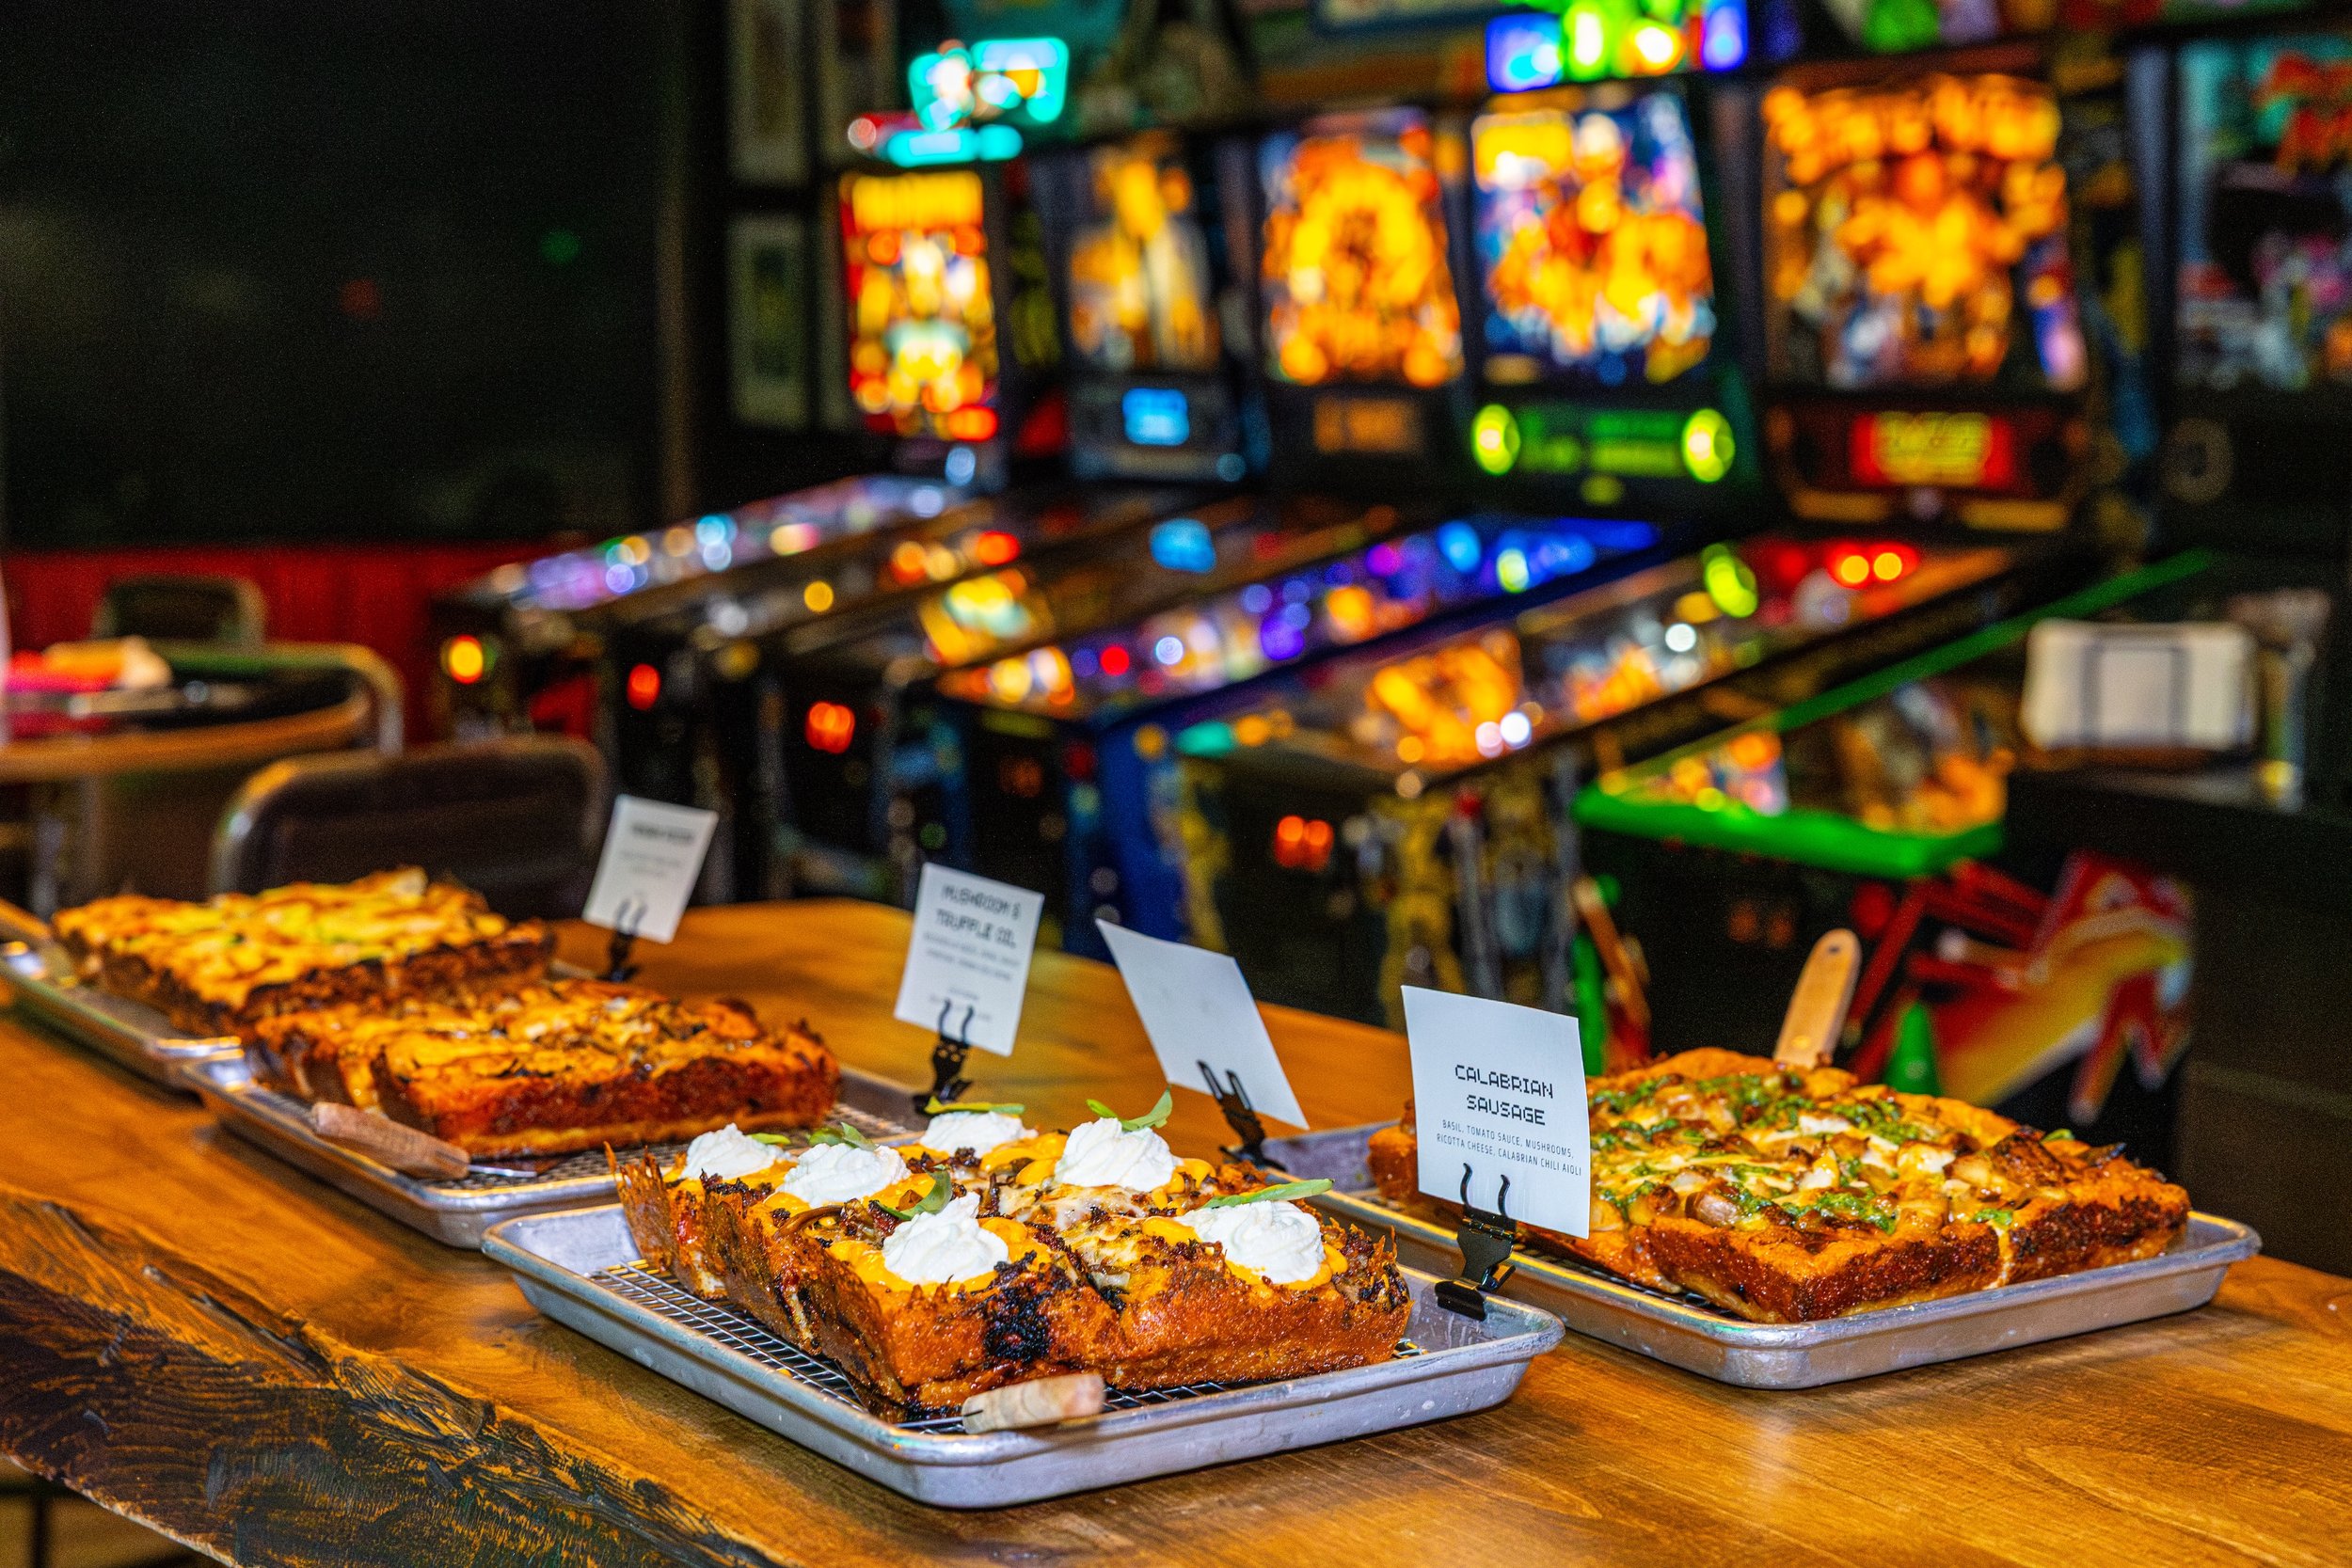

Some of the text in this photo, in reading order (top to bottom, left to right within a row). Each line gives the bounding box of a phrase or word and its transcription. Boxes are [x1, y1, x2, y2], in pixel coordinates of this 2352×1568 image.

[936, 909, 993, 941] TRUFFLE
[1454, 1064, 1553, 1099] CALABRIAN
[1467, 1094, 1546, 1126] SAUSAGE
[1437, 1133, 1581, 1177] RICOTTA CHEESE, CALABRIAN CHILI AIOLI
[1442, 1119, 1574, 1159] BASIL, TOMATO SAUCE, MUSHROOMS,
